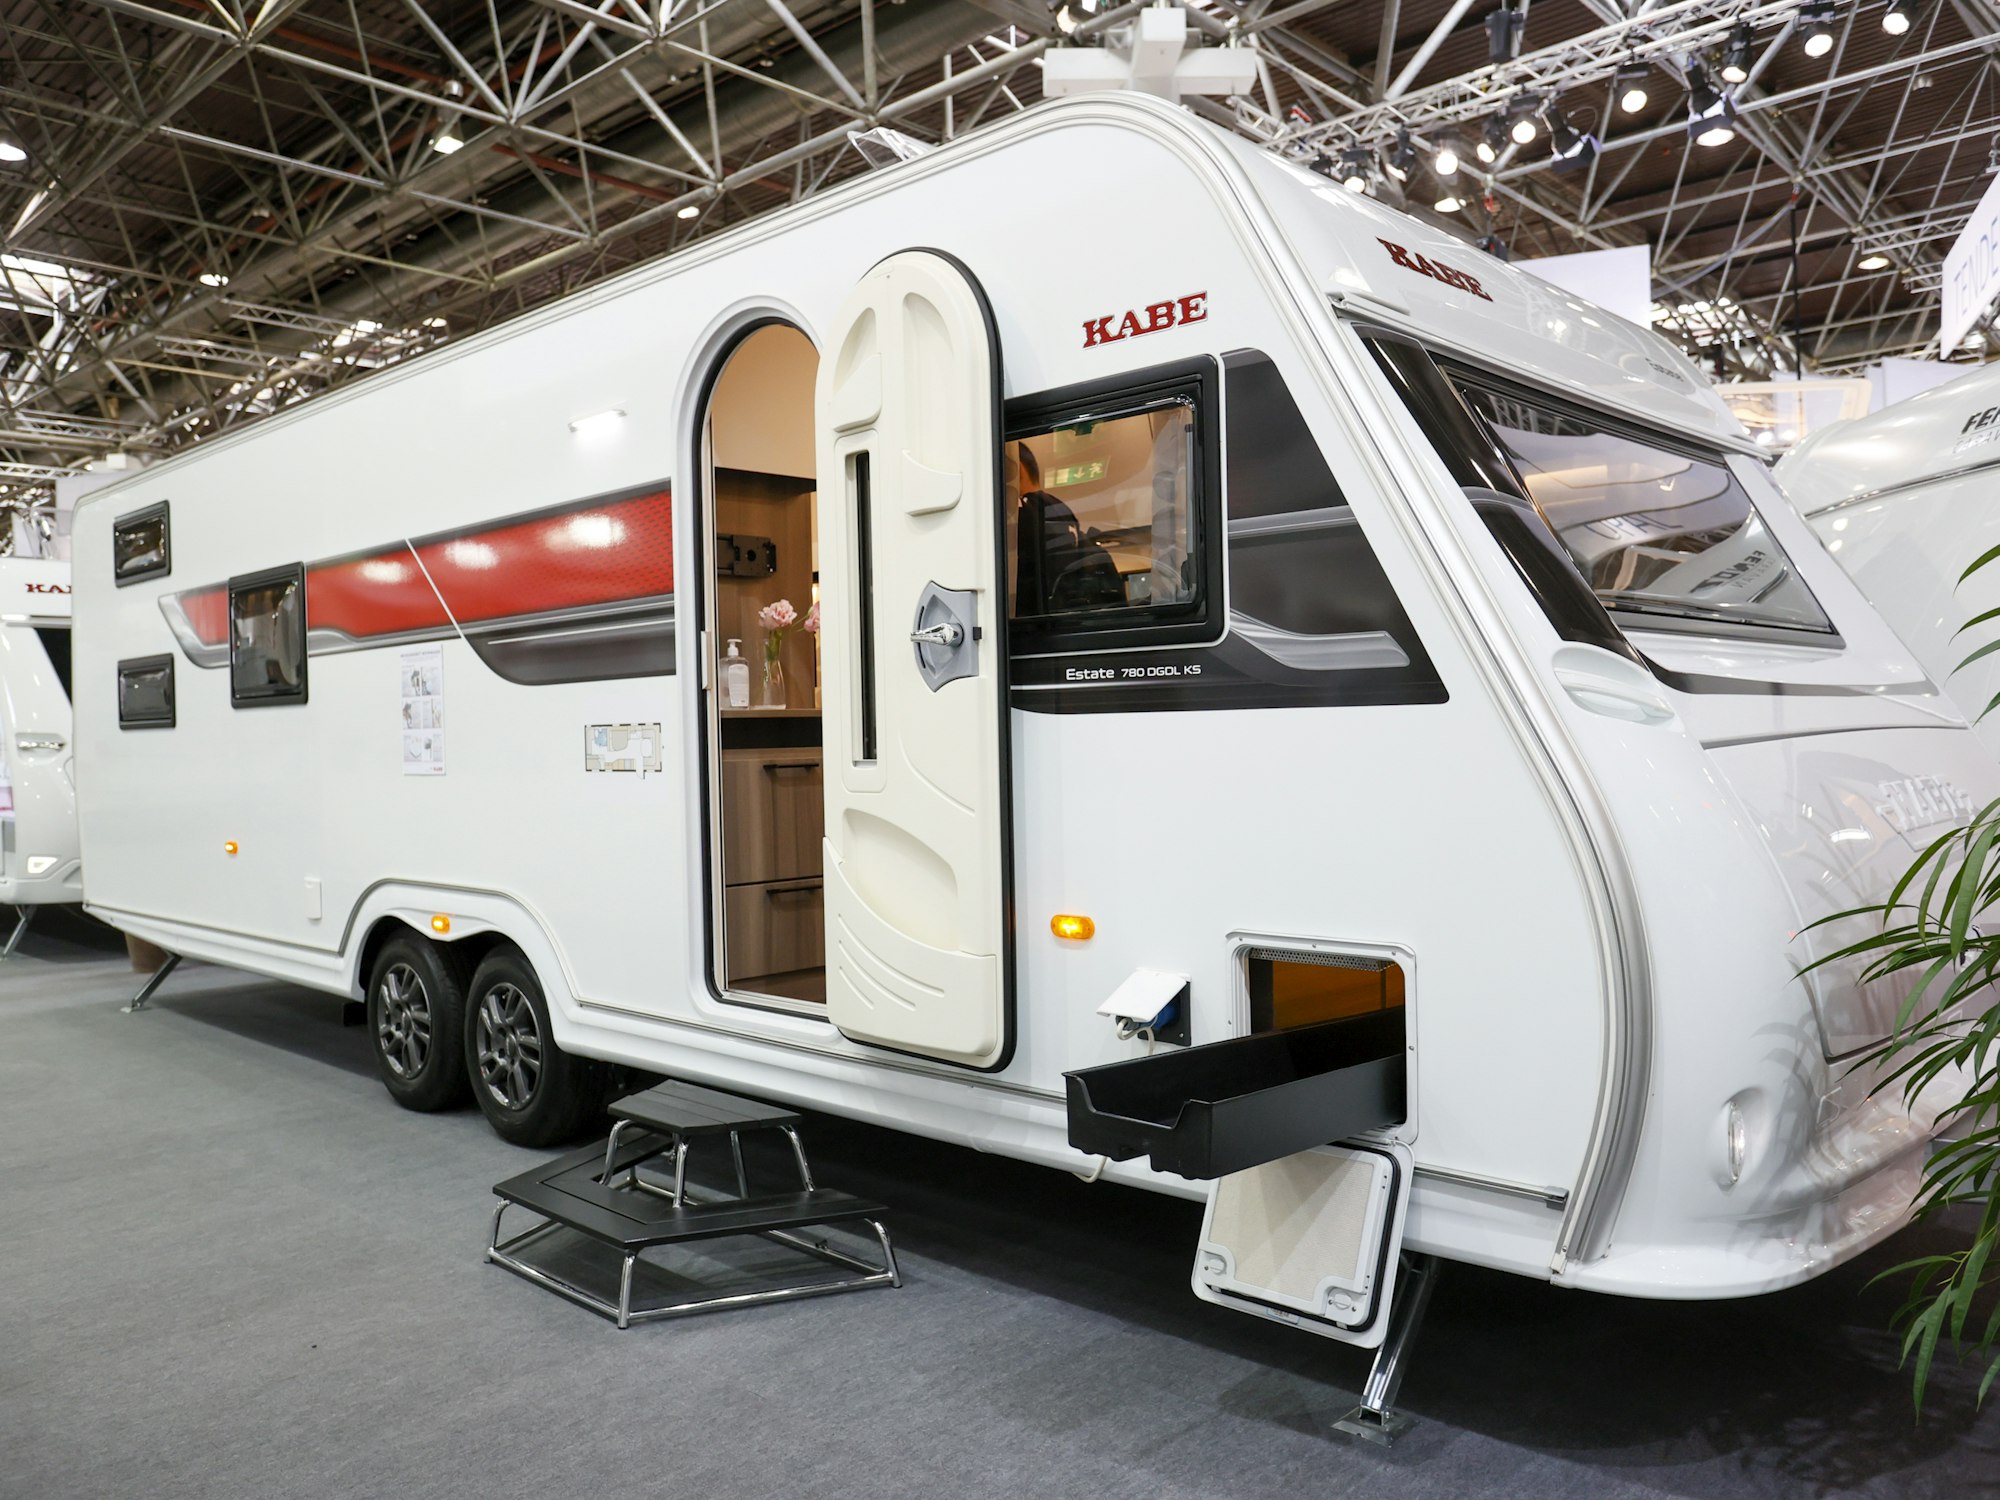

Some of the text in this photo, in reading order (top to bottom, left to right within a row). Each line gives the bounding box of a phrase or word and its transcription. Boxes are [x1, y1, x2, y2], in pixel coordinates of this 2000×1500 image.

[1375, 236, 1494, 302] KABE
[1082, 291, 1208, 349] KABE
[1066, 665, 1202, 681] Estate 780 DGDL KS
